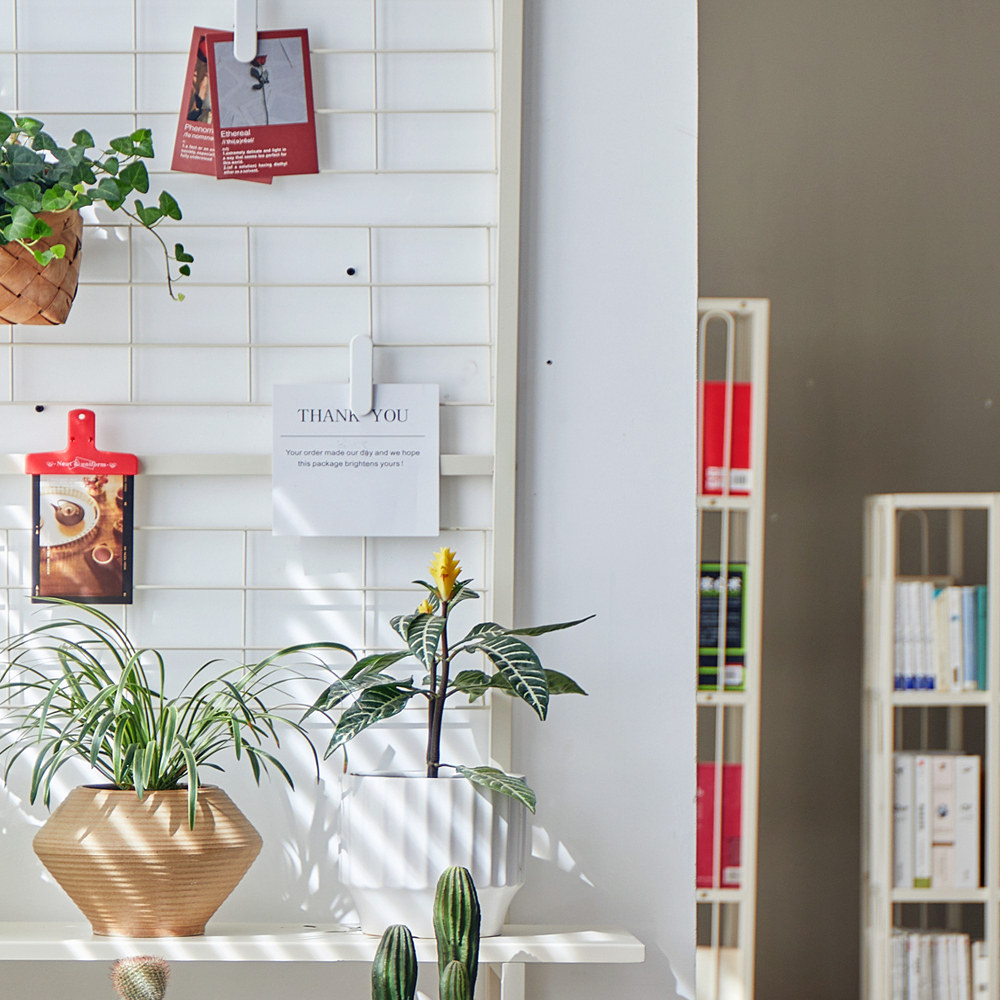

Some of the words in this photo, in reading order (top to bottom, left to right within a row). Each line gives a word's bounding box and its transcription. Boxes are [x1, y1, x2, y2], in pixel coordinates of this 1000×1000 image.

[221, 129, 251, 138] Ethereal
[371, 408, 408, 422] YOU
[360, 449, 373, 458] day
[402, 449, 420, 458] hope
[312, 460, 343, 469] package
[345, 460, 378, 469] brightens
